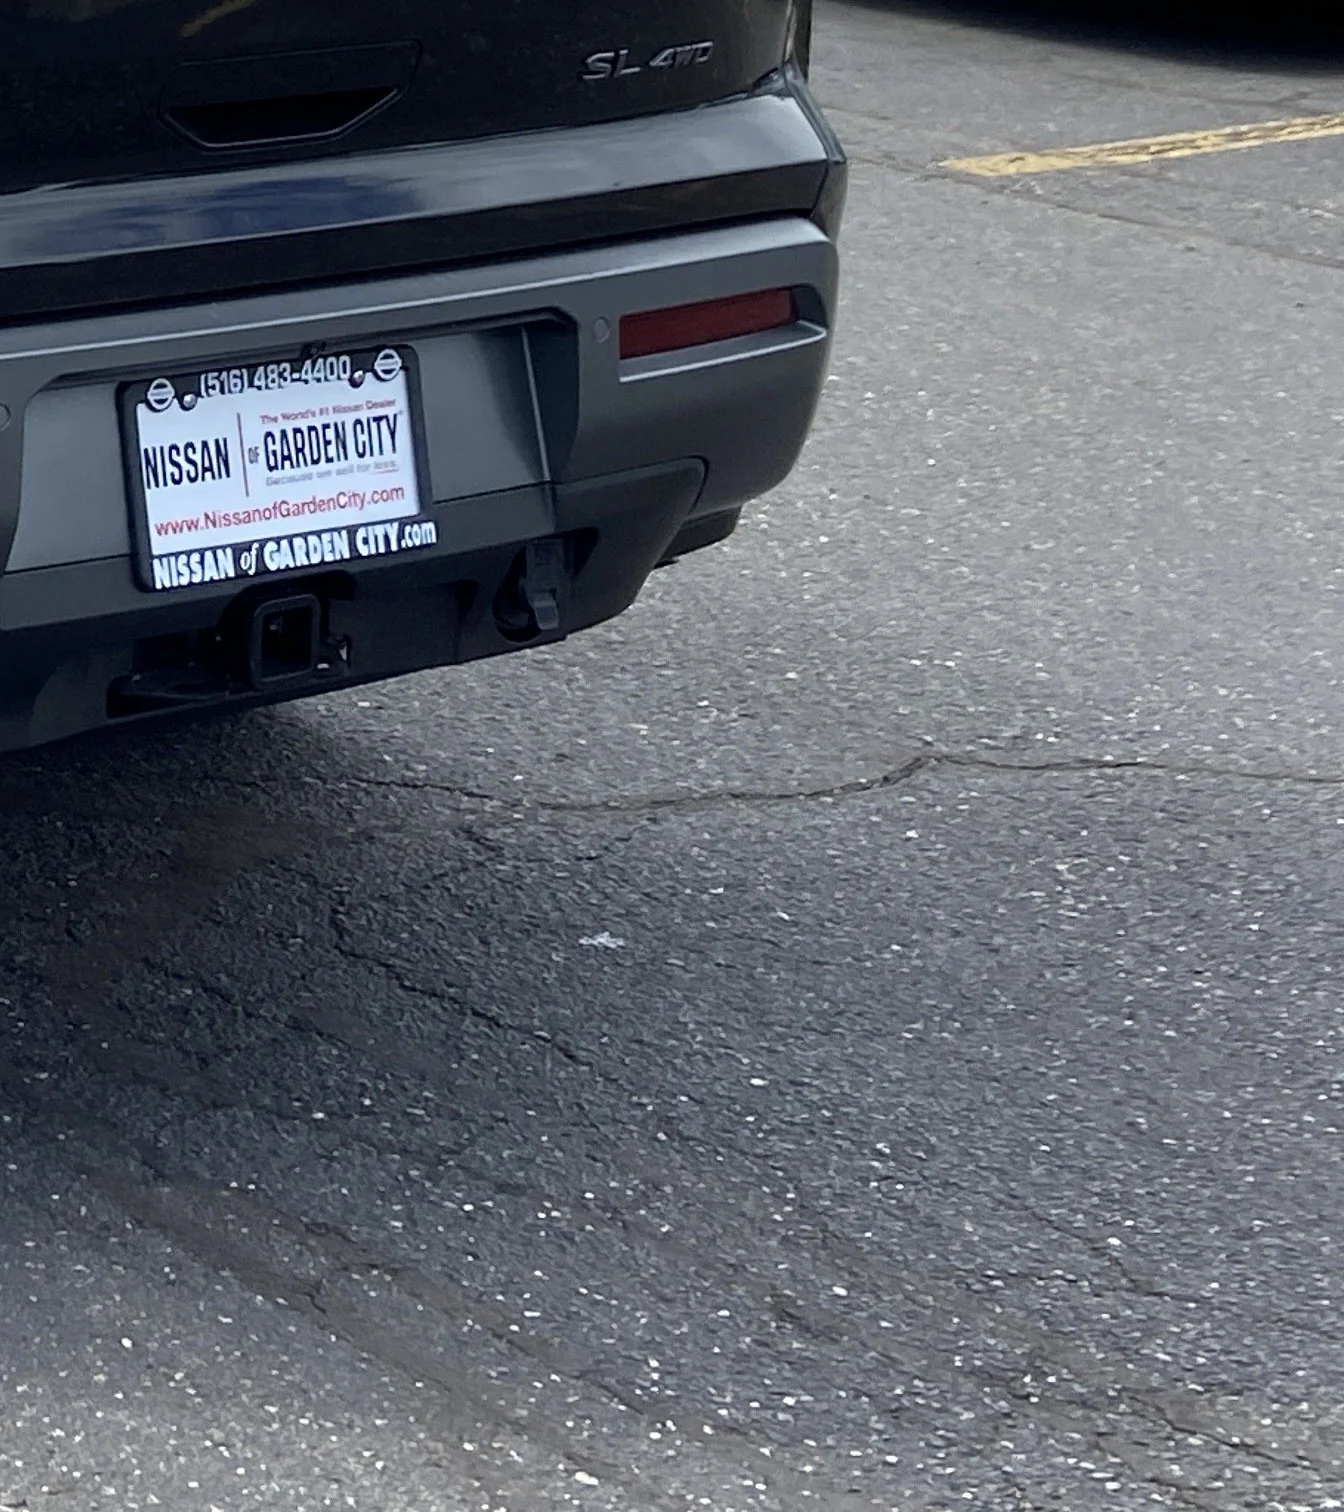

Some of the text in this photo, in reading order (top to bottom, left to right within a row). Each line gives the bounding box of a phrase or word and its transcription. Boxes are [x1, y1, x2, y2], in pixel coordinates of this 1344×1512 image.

[581, 40, 714, 80] SL 4WD
[199, 354, 352, 399] (516) 483-4400
[144, 413, 399, 489] NISSAN OF GARDEN CITY
[154, 485, 405, 538] www.NissanofGardenCity.com
[151, 520, 438, 590] NISSAN of GARDEN CITY.com
